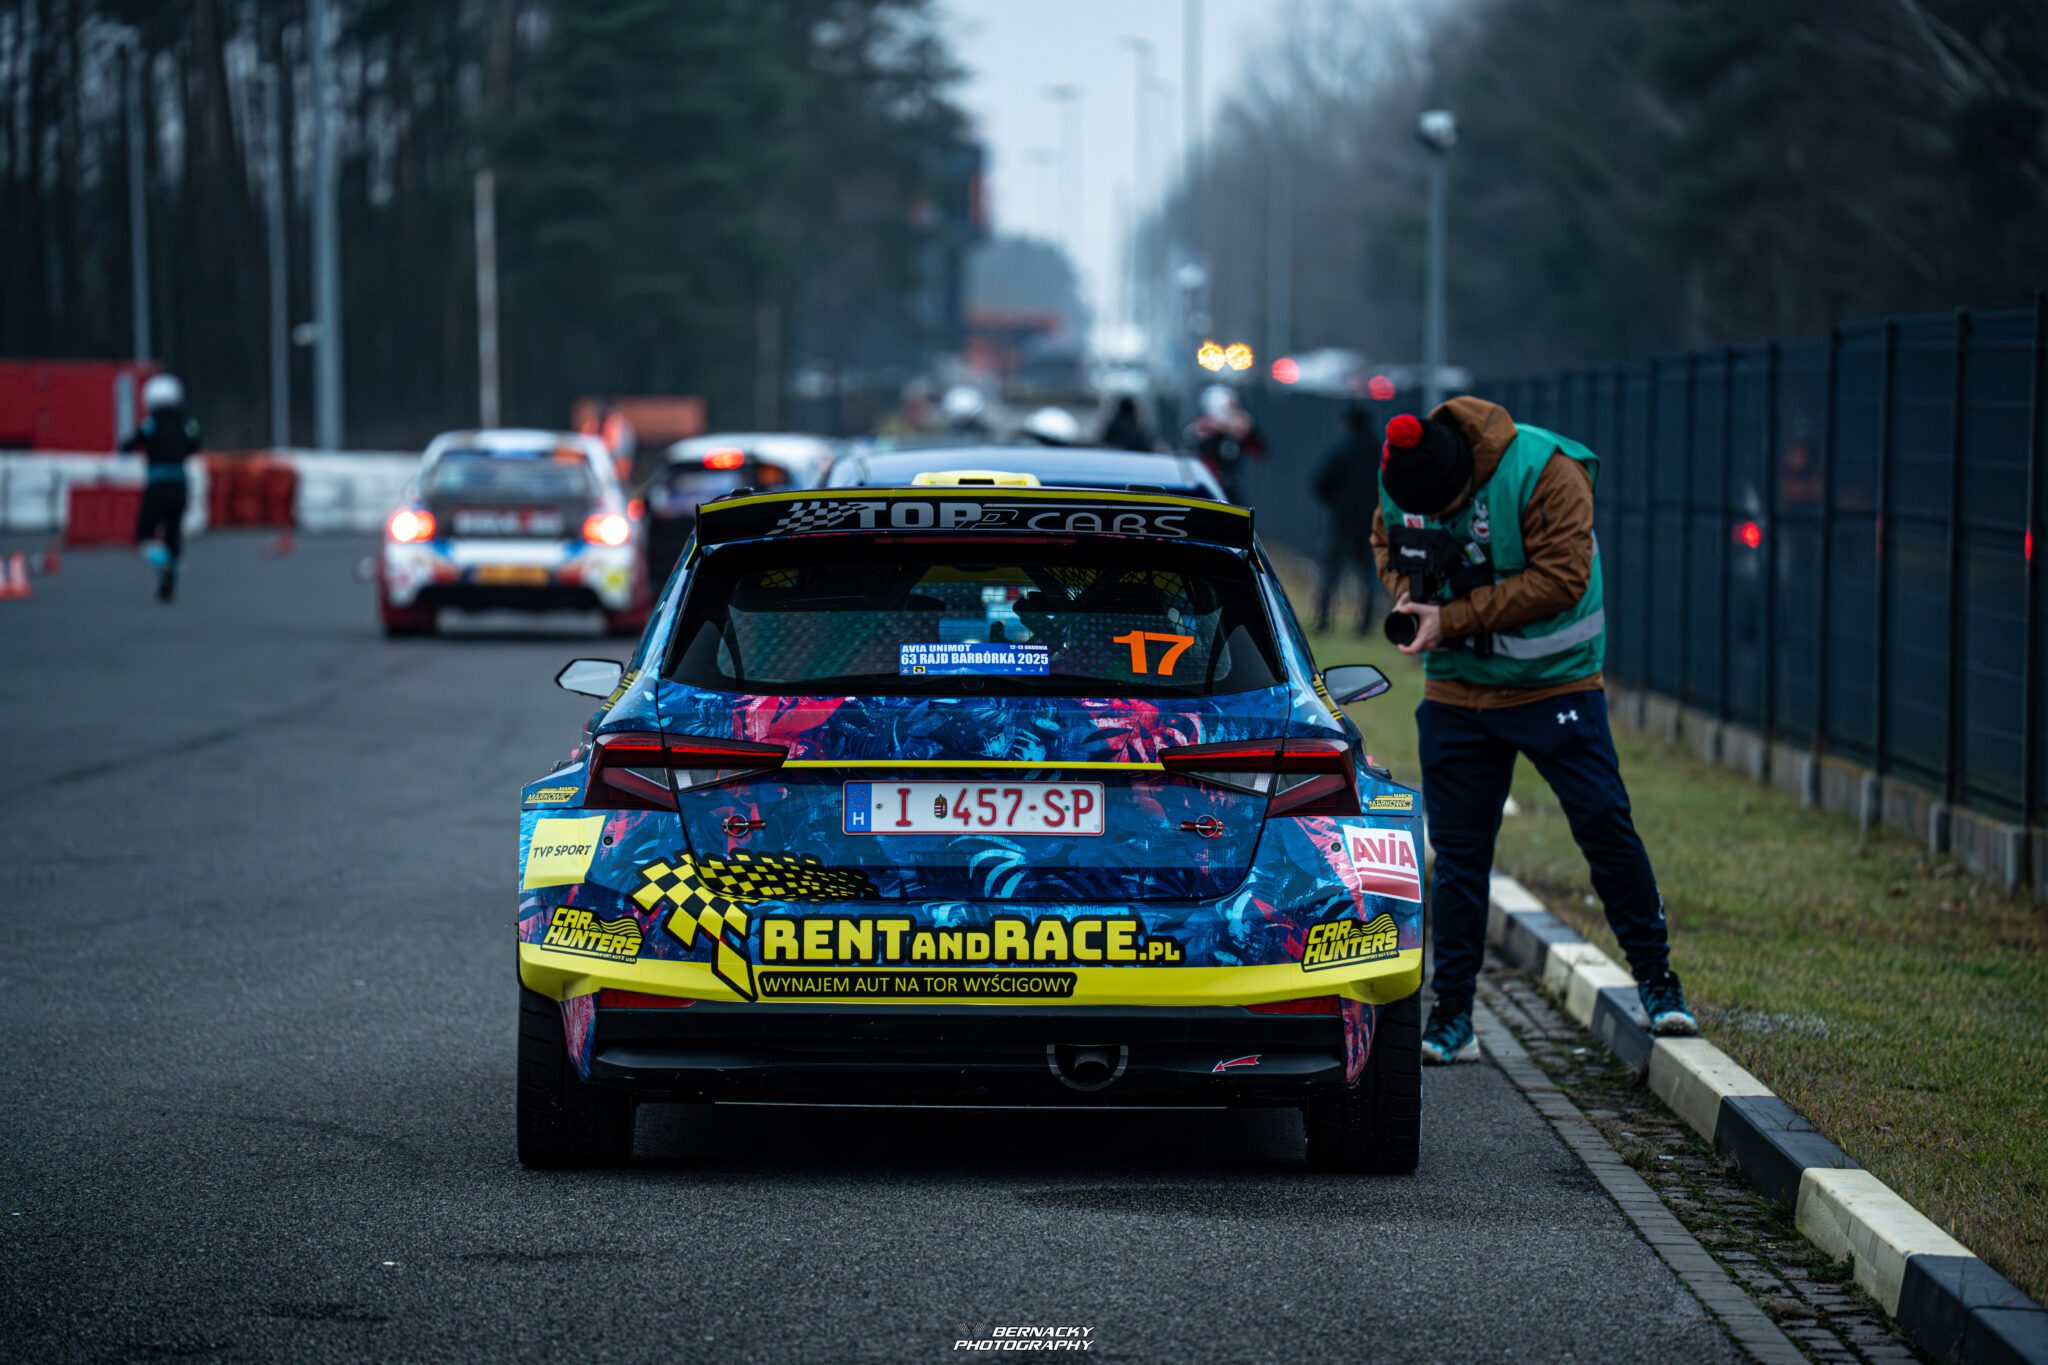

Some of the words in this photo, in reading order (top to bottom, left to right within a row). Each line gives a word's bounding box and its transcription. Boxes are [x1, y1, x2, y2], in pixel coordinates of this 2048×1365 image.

[850, 502, 982, 529] TOP
[1027, 512, 1189, 538] CARS
[901, 645, 926, 653] AVIA
[928, 644, 972, 653] UNIMOT
[901, 653, 917, 665] 63
[919, 653, 949, 664] RAJD
[951, 651, 1016, 664] BARBÓRKA
[1017, 653, 1049, 665] 2025
[1112, 630, 1196, 677] 17
[853, 811, 865, 826] H
[895, 787, 912, 827] I
[533, 845, 554, 859] TVP
[554, 844, 592, 857] SPORT
[552, 907, 593, 931] CAR
[543, 925, 643, 957] HUNTERS
[1308, 919, 1352, 945] CAR
[1303, 930, 1398, 965] HUNTERS
[763, 977, 849, 992] WYNAJEM
[854, 977, 890, 992] AUT
[895, 977, 919, 992] NA
[924, 977, 958, 992] TOR
[963, 974, 1071, 993] WYŚCIGOWY
